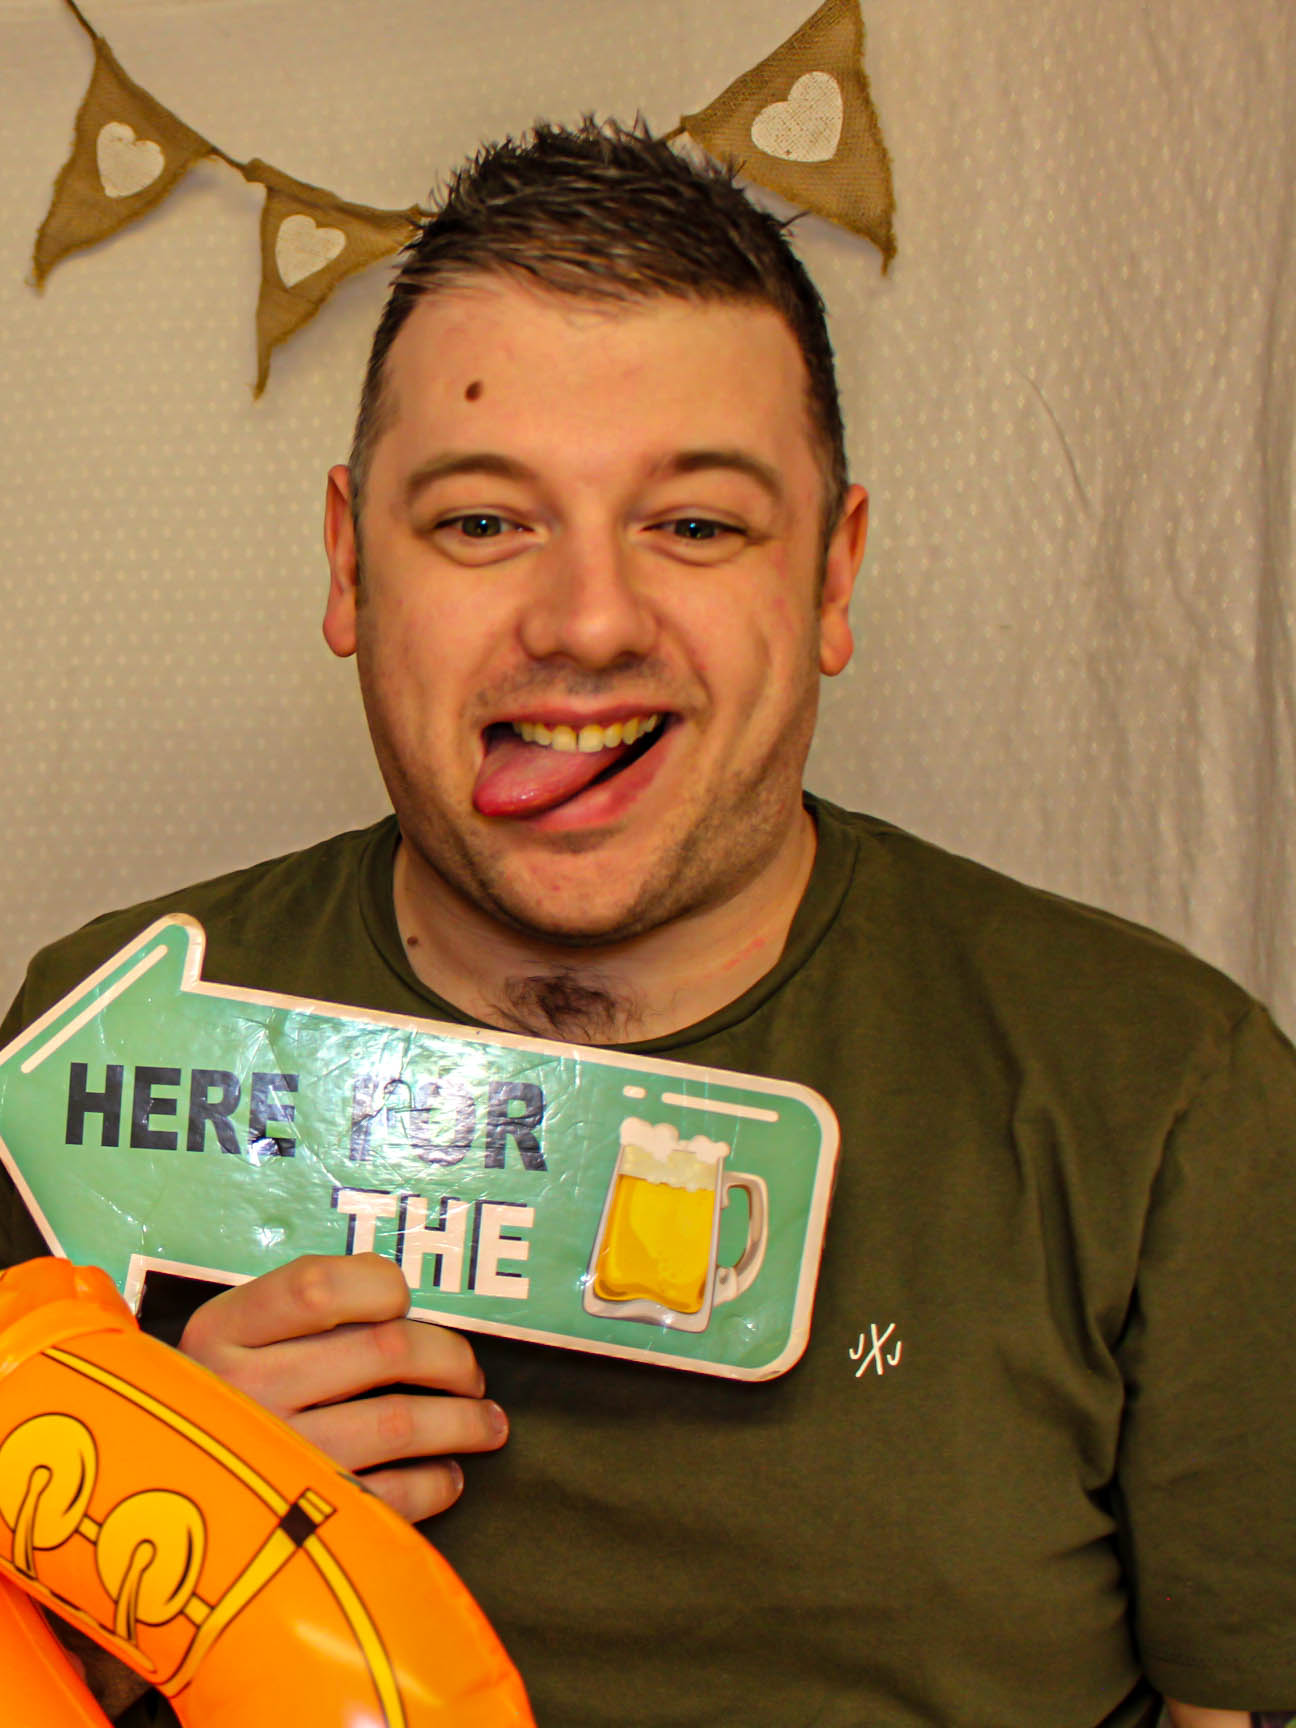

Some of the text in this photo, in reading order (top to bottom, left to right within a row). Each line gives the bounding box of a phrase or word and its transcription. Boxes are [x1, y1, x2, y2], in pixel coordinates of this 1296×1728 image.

[64, 1062, 548, 1172] HERE FOR
[332, 1185, 535, 1299] THE
